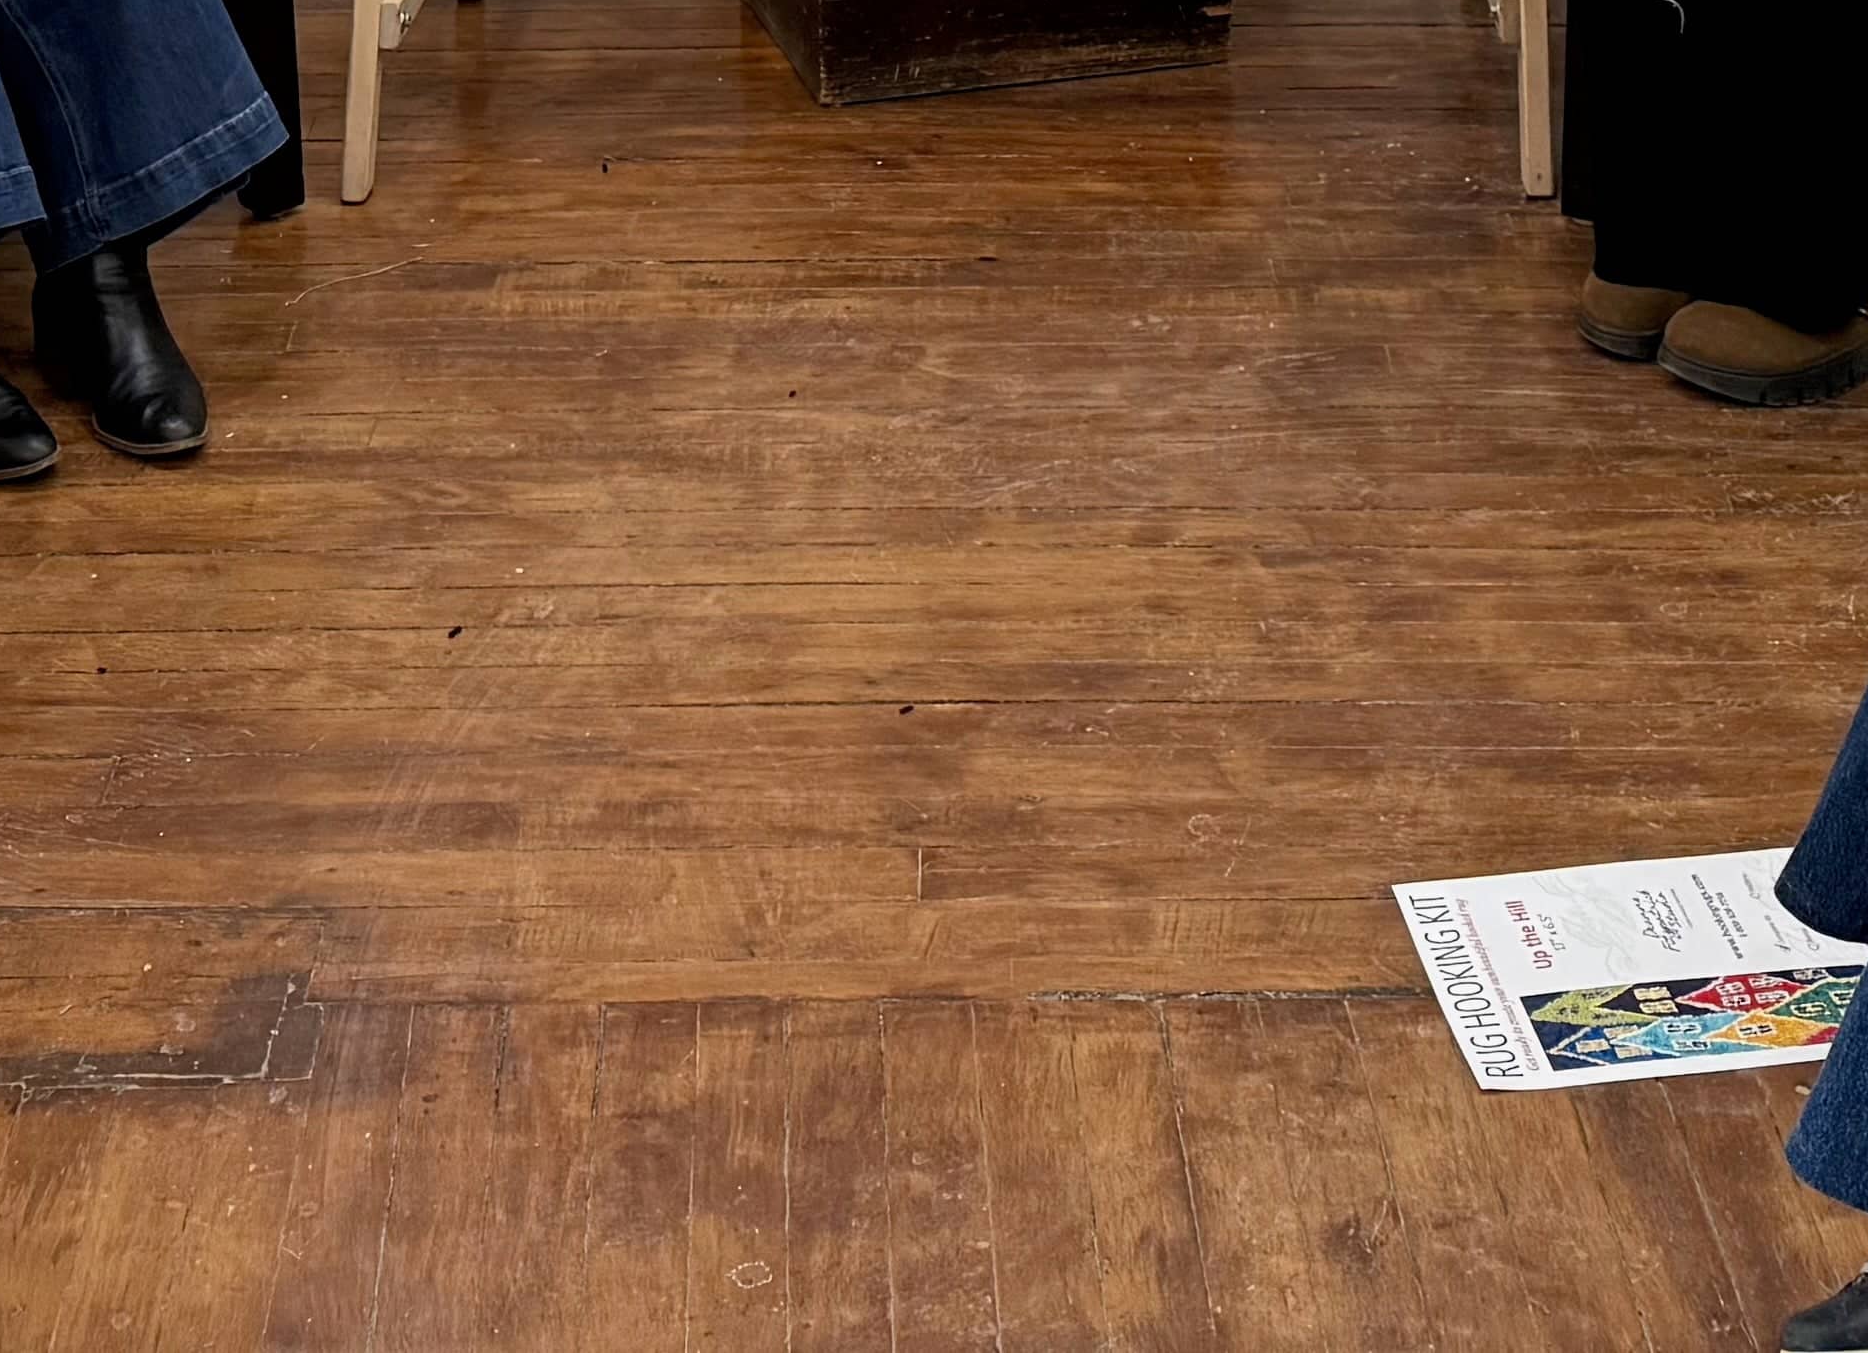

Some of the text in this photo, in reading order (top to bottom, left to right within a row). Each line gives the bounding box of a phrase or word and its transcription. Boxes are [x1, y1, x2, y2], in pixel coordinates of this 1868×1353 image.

[1409, 895, 1524, 1078] RUG HOOKING KIT
[1504, 900, 1554, 970] Up the Hill
